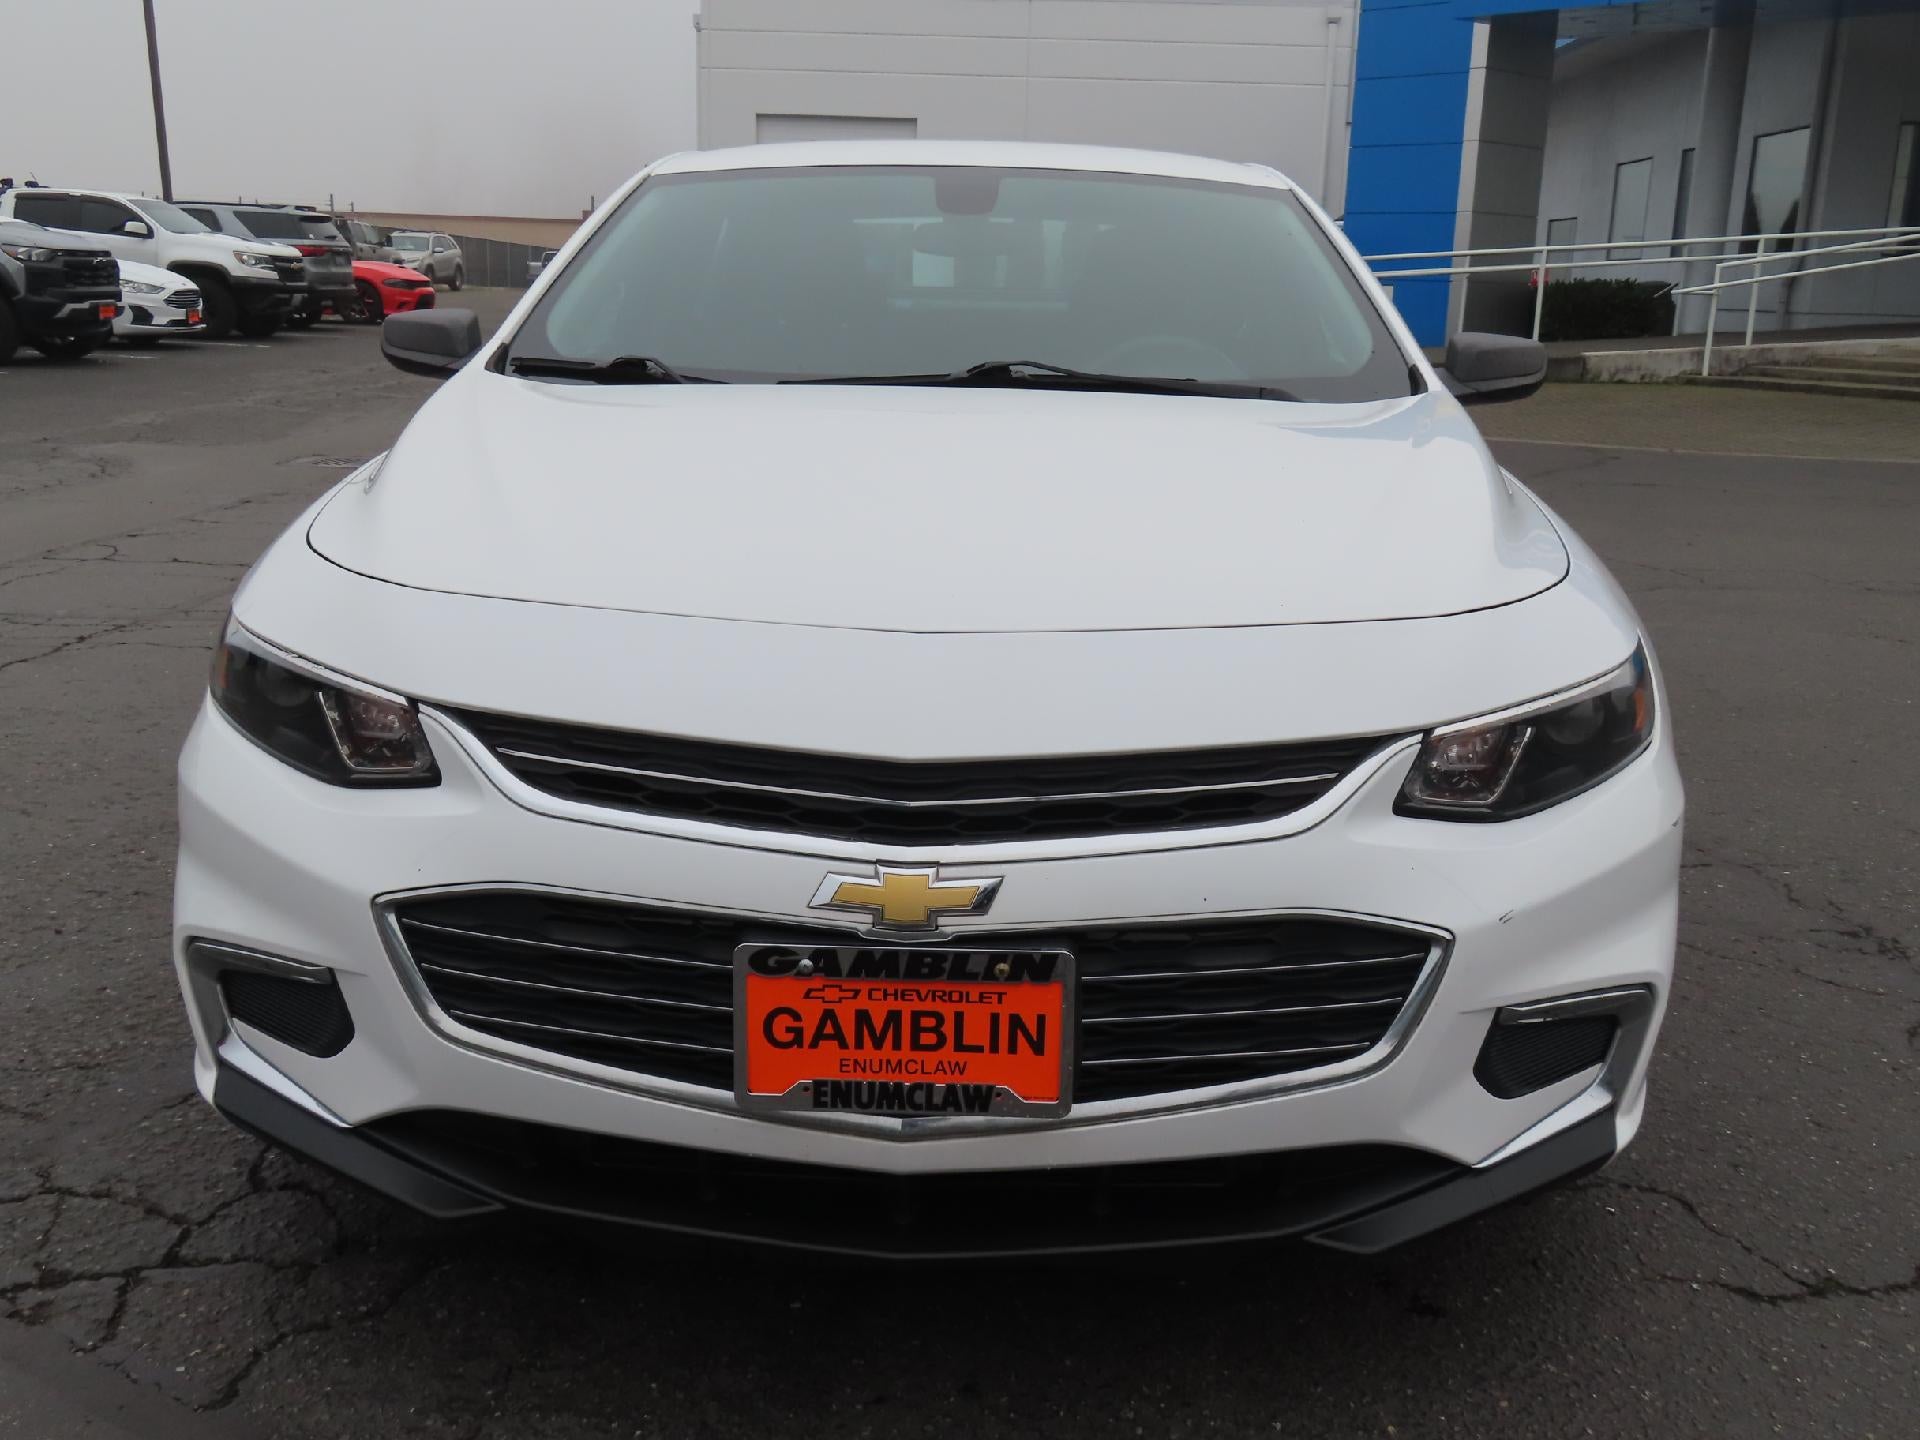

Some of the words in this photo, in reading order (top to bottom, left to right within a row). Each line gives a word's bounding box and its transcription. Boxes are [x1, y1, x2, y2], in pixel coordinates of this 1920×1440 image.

[749, 946, 1059, 982] GAMBLIN
[867, 987, 1007, 1004] CHEVROLET
[763, 1007, 1046, 1056] GAMBLIN
[839, 1058, 967, 1076] ENUMCLAW
[812, 1081, 995, 1113] ENUMCLAW
